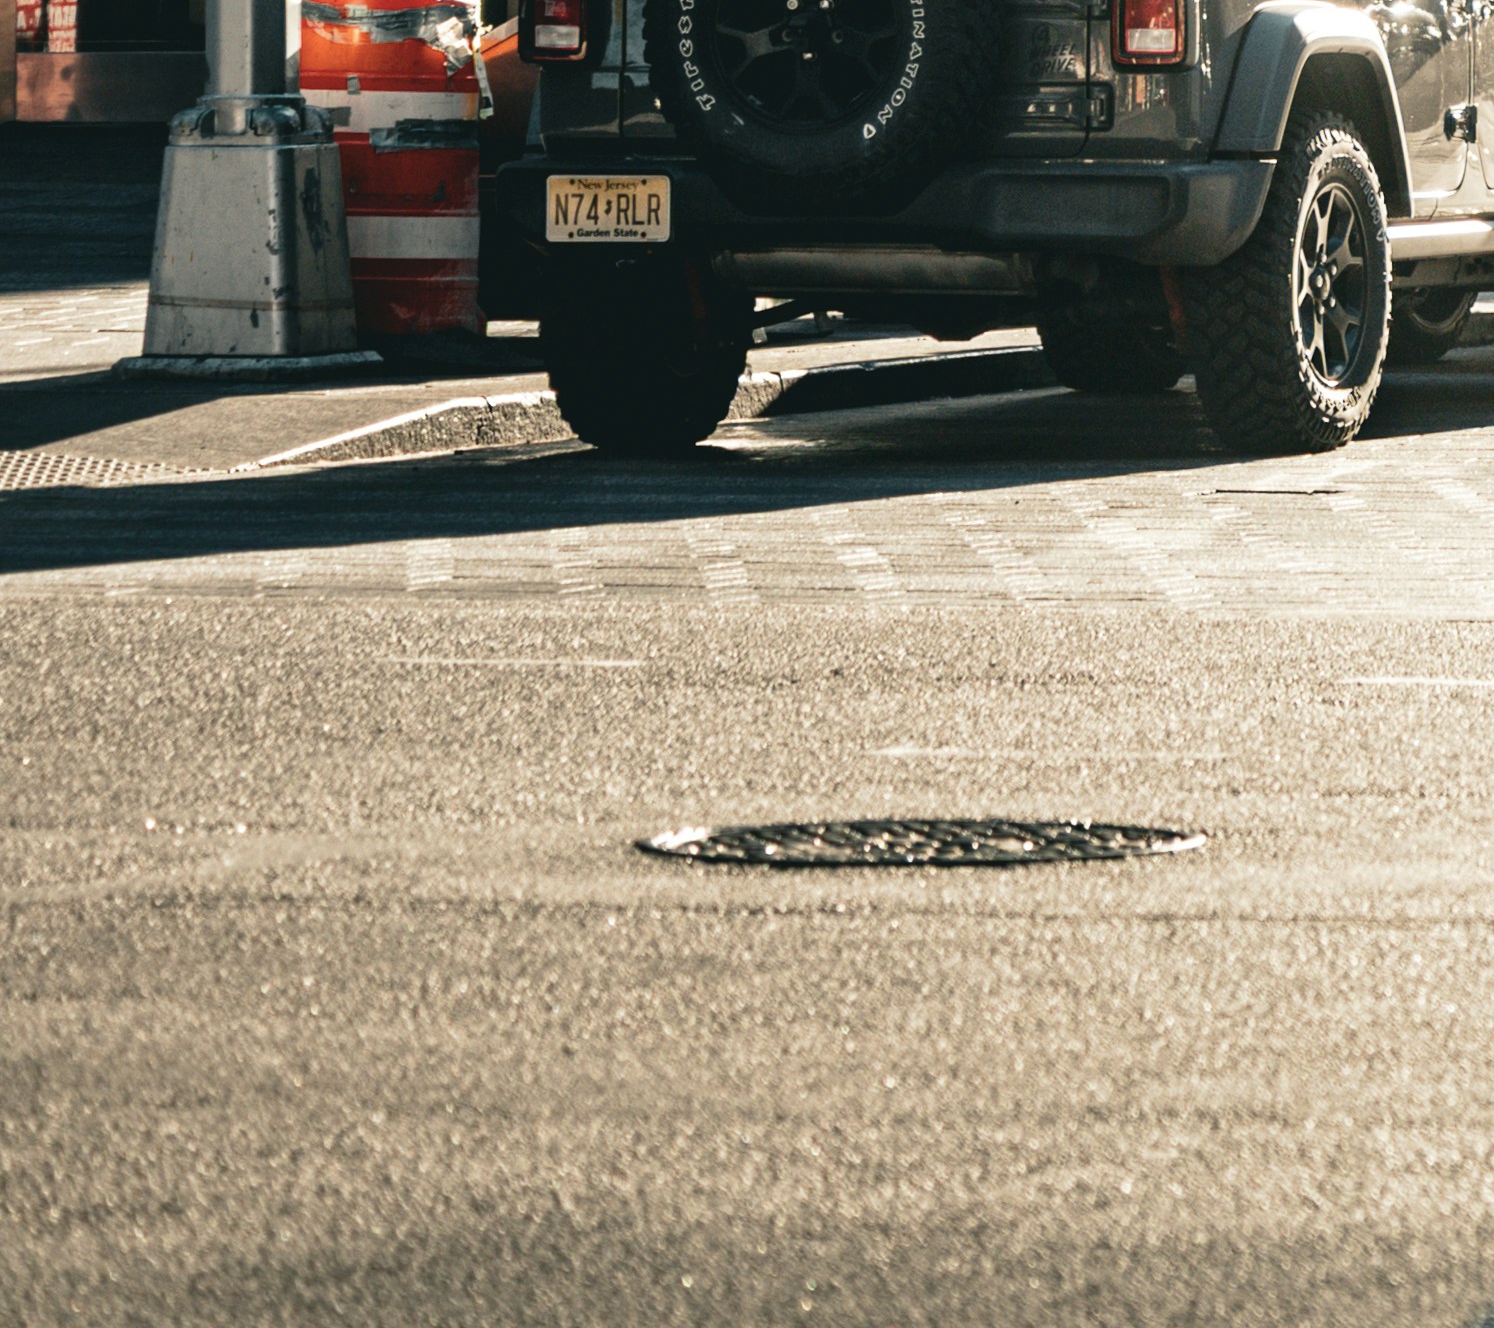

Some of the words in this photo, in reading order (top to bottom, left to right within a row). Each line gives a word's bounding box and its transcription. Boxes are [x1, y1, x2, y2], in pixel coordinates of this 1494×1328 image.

[577, 179, 602, 190] New
[604, 179, 640, 192] Jersey
[555, 193, 600, 226] N74
[616, 193, 661, 226] RLR
[576, 228, 611, 238] Garden
[613, 228, 639, 238] State
